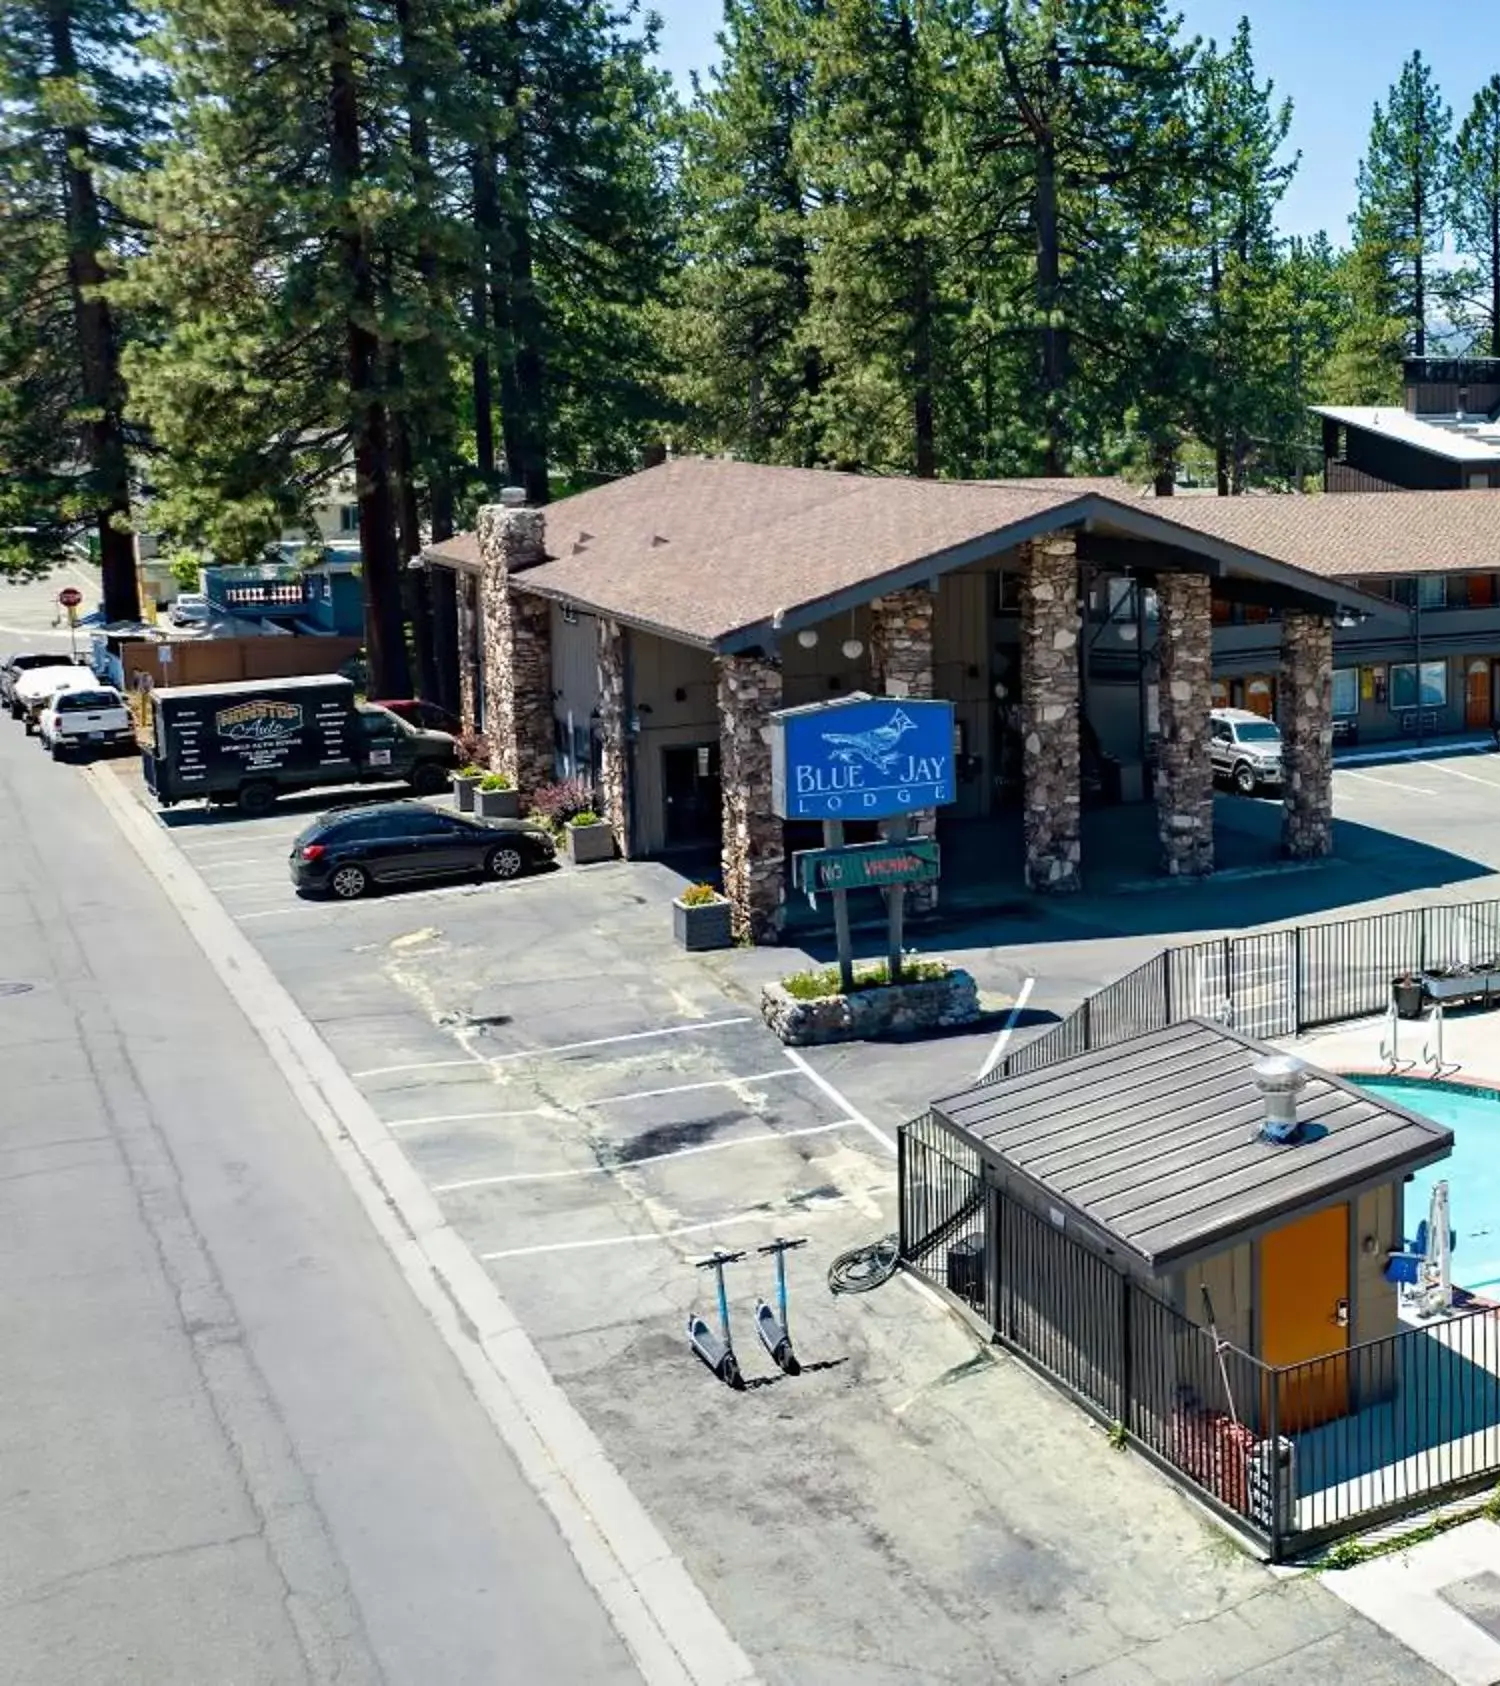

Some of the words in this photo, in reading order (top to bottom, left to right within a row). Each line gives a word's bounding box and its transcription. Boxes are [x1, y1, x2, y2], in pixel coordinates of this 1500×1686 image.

[797, 765, 864, 793] BLUE
[900, 756, 946, 783] JAY
[799, 786, 945, 813] LODGE
[821, 862, 842, 882] NO
